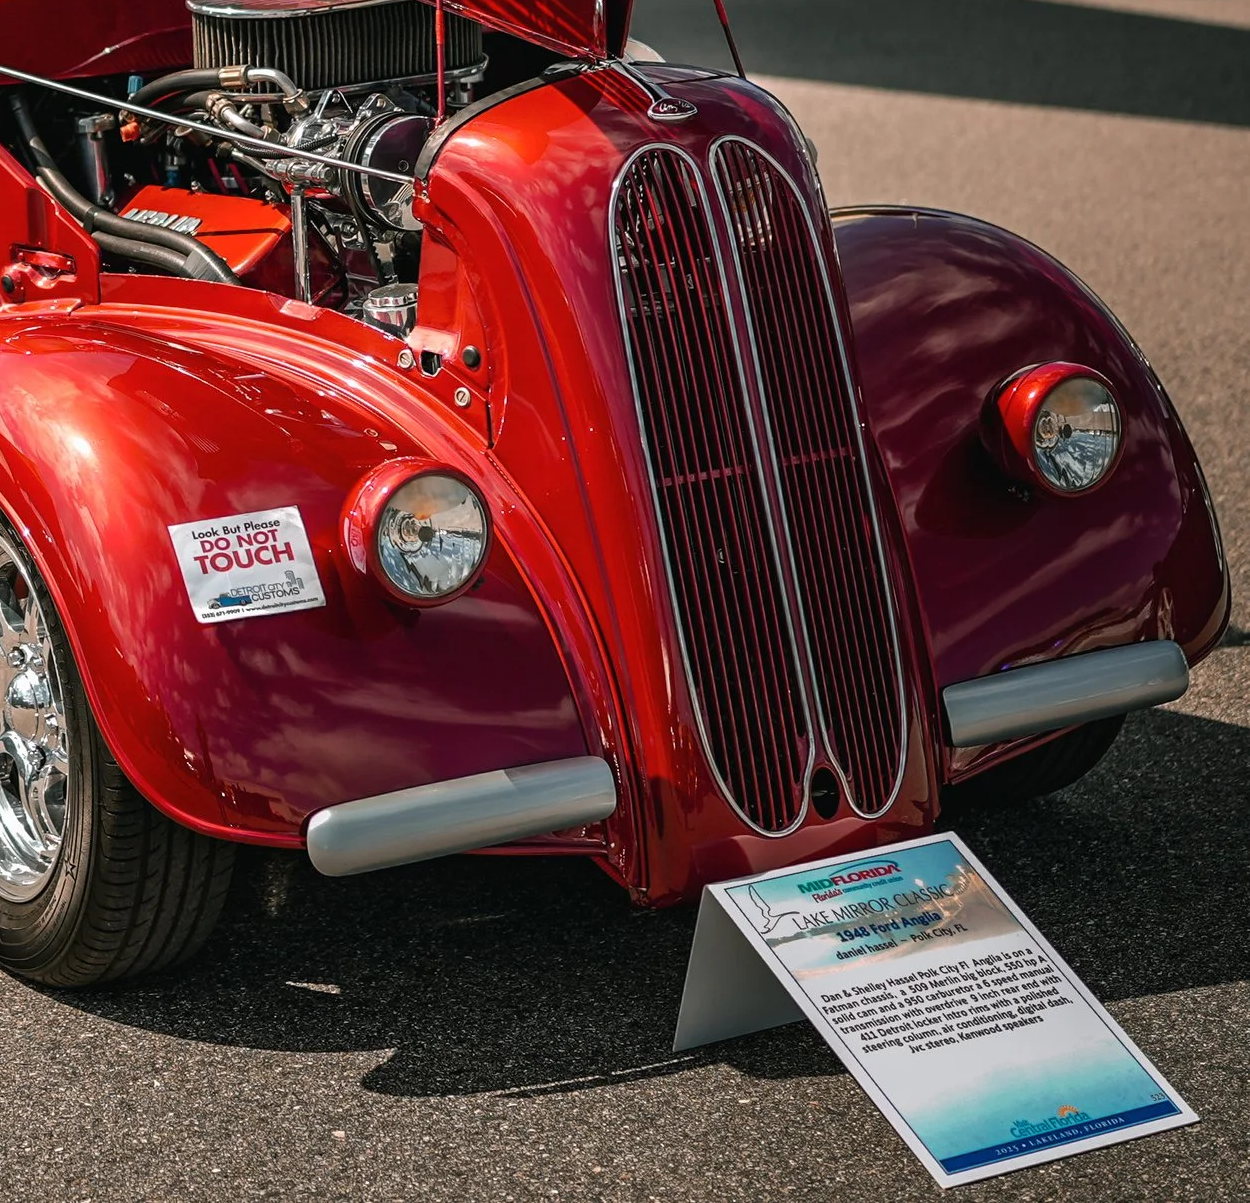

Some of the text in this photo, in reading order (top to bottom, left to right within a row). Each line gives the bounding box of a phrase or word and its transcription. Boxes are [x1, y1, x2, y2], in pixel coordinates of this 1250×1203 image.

[192, 519, 281, 540] Look But Please
[200, 529, 278, 553] DO NOT
[194, 542, 295, 574] TOUCH
[231, 584, 266, 596] DETROIT
[251, 587, 300, 601] CUSTOMS
[798, 864, 902, 894] MIDFLORIDA
[792, 883, 954, 930] LAKE MIRROR CLASSIC
[836, 911, 943, 942] 1948 Ford Anglia
[836, 945, 867, 960] daniel
[865, 940, 898, 953] hassel
[910, 931, 932, 943] Polk
[931, 925, 956, 939] City,
[953, 923, 968, 933] FL
[821, 994, 842, 1003] Dan
[843, 990, 852, 998] &
[851, 982, 887, 995] Shelley
[886, 974, 918, 987] Hassel
[917, 968, 939, 979] Polk
[939, 965, 959, 974] City
[972, 954, 1003, 967] Anglia
[1012, 949, 1025, 957] on
[822, 1001, 860, 1015] Fatman
[861, 992, 897, 1005] chassis,
[908, 983, 928, 994] 509
[929, 975, 961, 988] Merlin
[961, 972, 978, 981] big
[976, 965, 1006, 978] block,
[1005, 960, 1023, 971] 550
[1023, 958, 1037, 967] hp
[1038, 955, 1047, 963] A
[832, 1012, 856, 1024] solid
[857, 1009, 878, 1018] cam
[879, 1003, 897, 1013] and
[904, 995, 924, 1006] 950
[926, 984, 974, 1001] carburetor
[991, 974, 1019, 986] speed
[1019, 965, 1054, 978] manual
[840, 975, 1062, 1034] transmission with overdrive 9 inch rear end with
[861, 1032, 878, 1041] 411
[877, 1023, 913, 1036] Detroit
[912, 1015, 942, 1028] locker
[968, 1004, 990, 1015] rims
[990, 999, 1012, 1009] with
[1020, 987, 1059, 1003] polished
[862, 997, 1073, 1053] steering column, air conditioning, digital dash,
[957, 1024, 1003, 1041] Kenwood
[1002, 1015, 1044, 1031] speakers
[994, 1116, 1125, 1156] 2025 LAKELAND, FLORIDA
[1010, 1112, 1091, 1138] Central Florida
